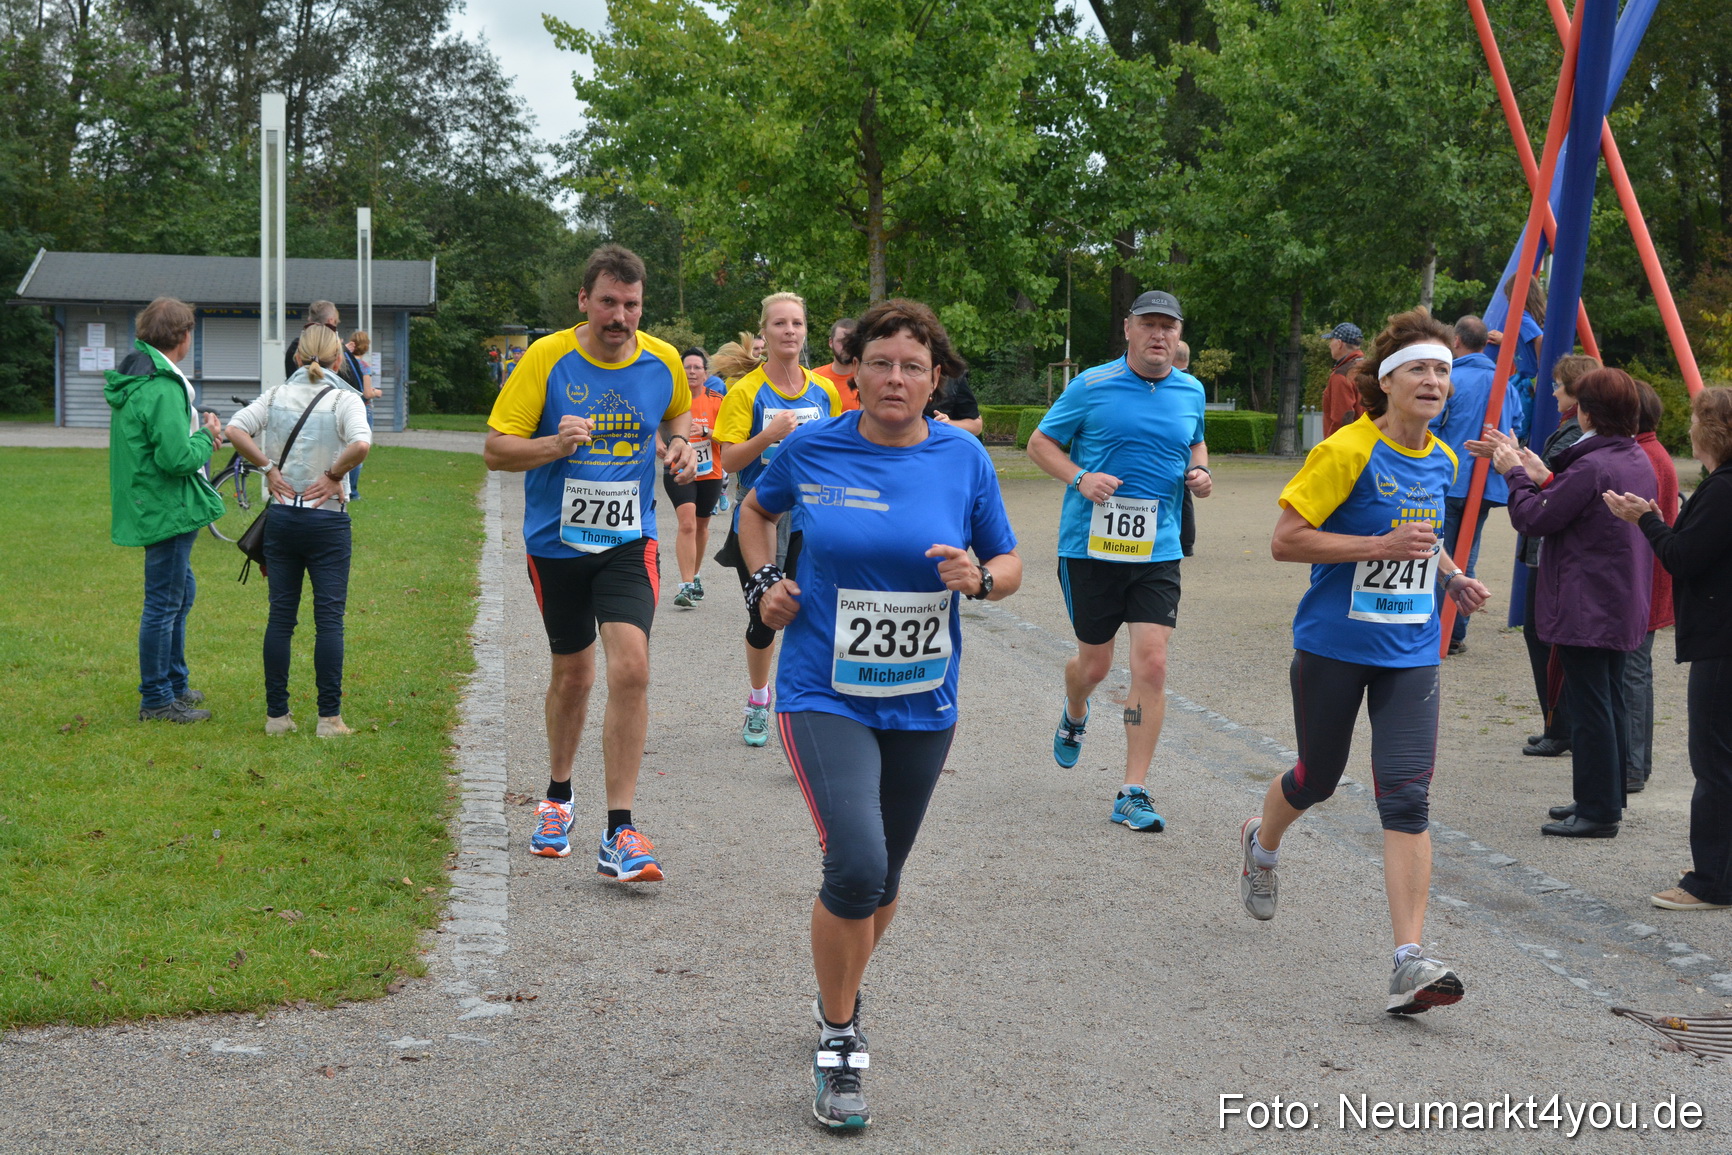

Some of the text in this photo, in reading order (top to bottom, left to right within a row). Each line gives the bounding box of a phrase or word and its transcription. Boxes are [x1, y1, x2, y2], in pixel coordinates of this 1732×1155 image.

[696, 448, 709, 462] 31
[566, 486, 630, 497] PARTL Neumarkt
[570, 498, 634, 527] 2784
[1116, 503, 1149, 512] Neumarkt
[1104, 512, 1146, 538] 168
[581, 530, 623, 545] Thomas
[1103, 541, 1139, 553] Michael
[1363, 559, 1429, 589] 2241
[840, 600, 936, 614] PARTL Neumarkt
[1375, 598, 1413, 614] Margrit
[848, 616, 941, 658] 2332
[858, 666, 926, 683] Michaela
